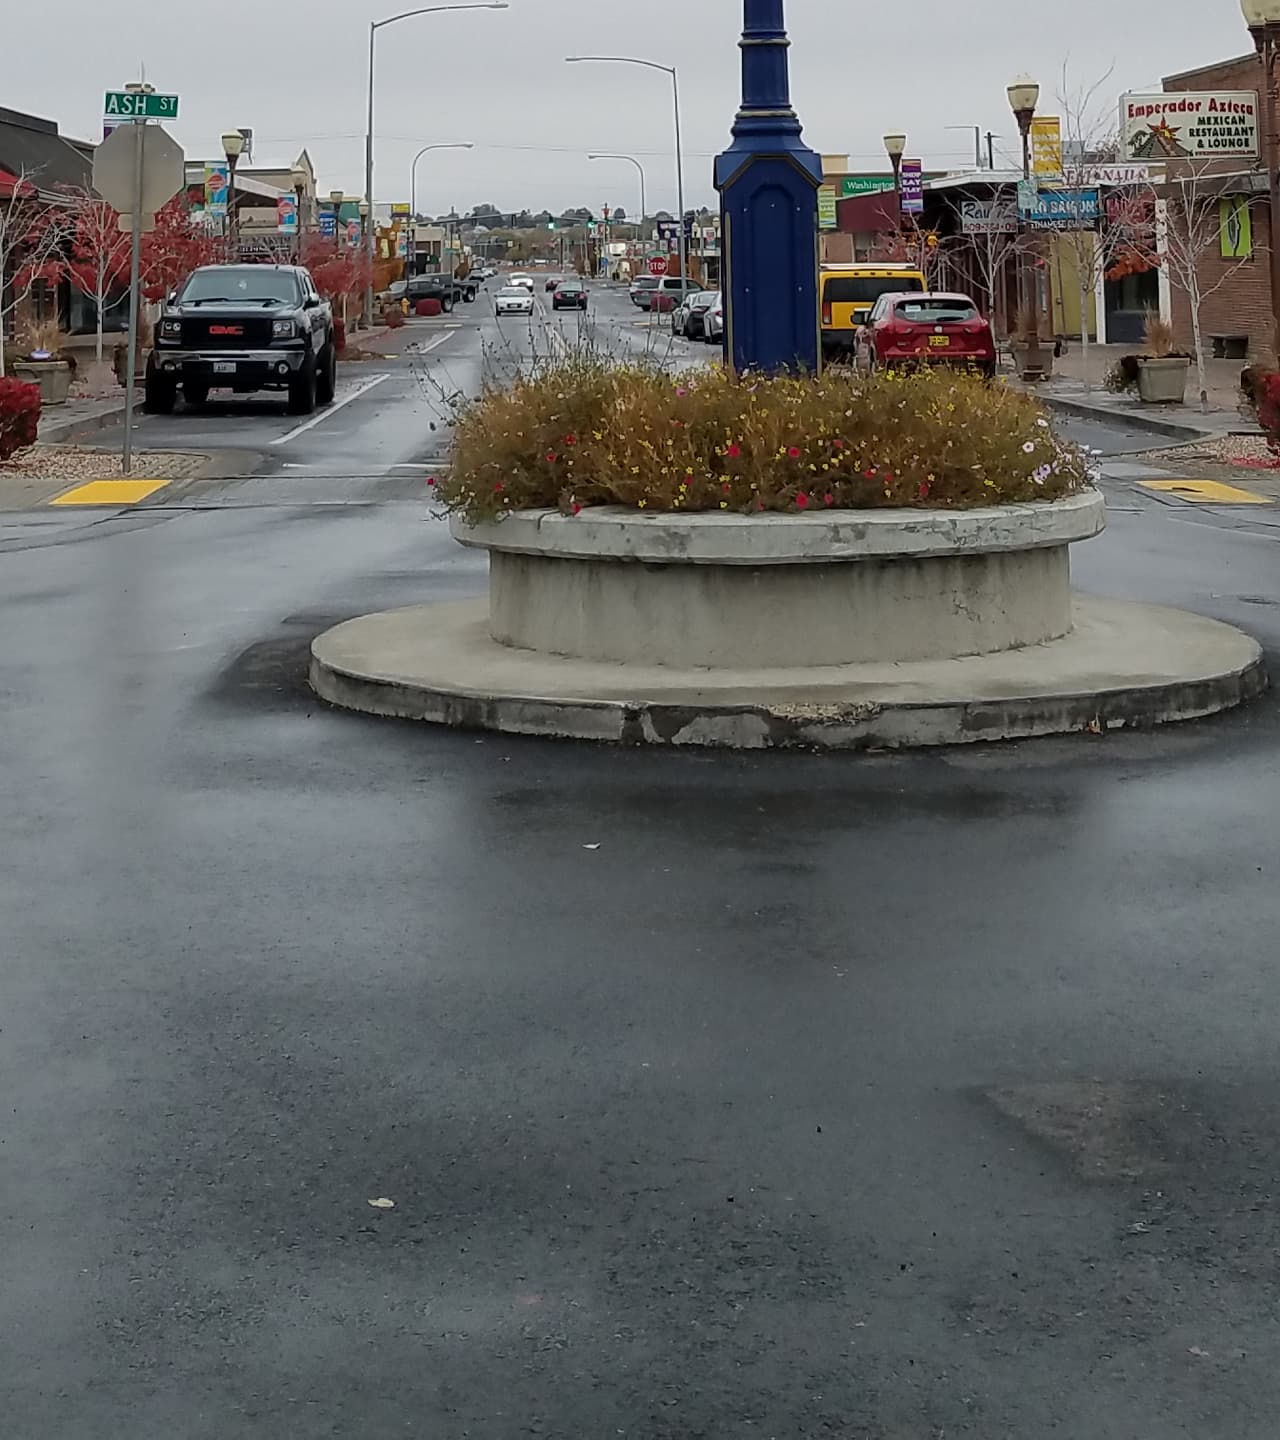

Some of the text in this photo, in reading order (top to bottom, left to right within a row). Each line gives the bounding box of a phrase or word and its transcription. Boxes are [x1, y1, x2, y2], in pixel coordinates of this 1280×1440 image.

[107, 94, 177, 115] ASH ST
[1127, 97, 1254, 118] Emperador Azteca
[1197, 115, 1246, 126] MEXICAN
[1189, 126, 1255, 137] RESTAURANT
[1197, 138, 1250, 149] & LOUNGE
[649, 260, 666, 271] STOP
[209, 326, 244, 335] GMC
